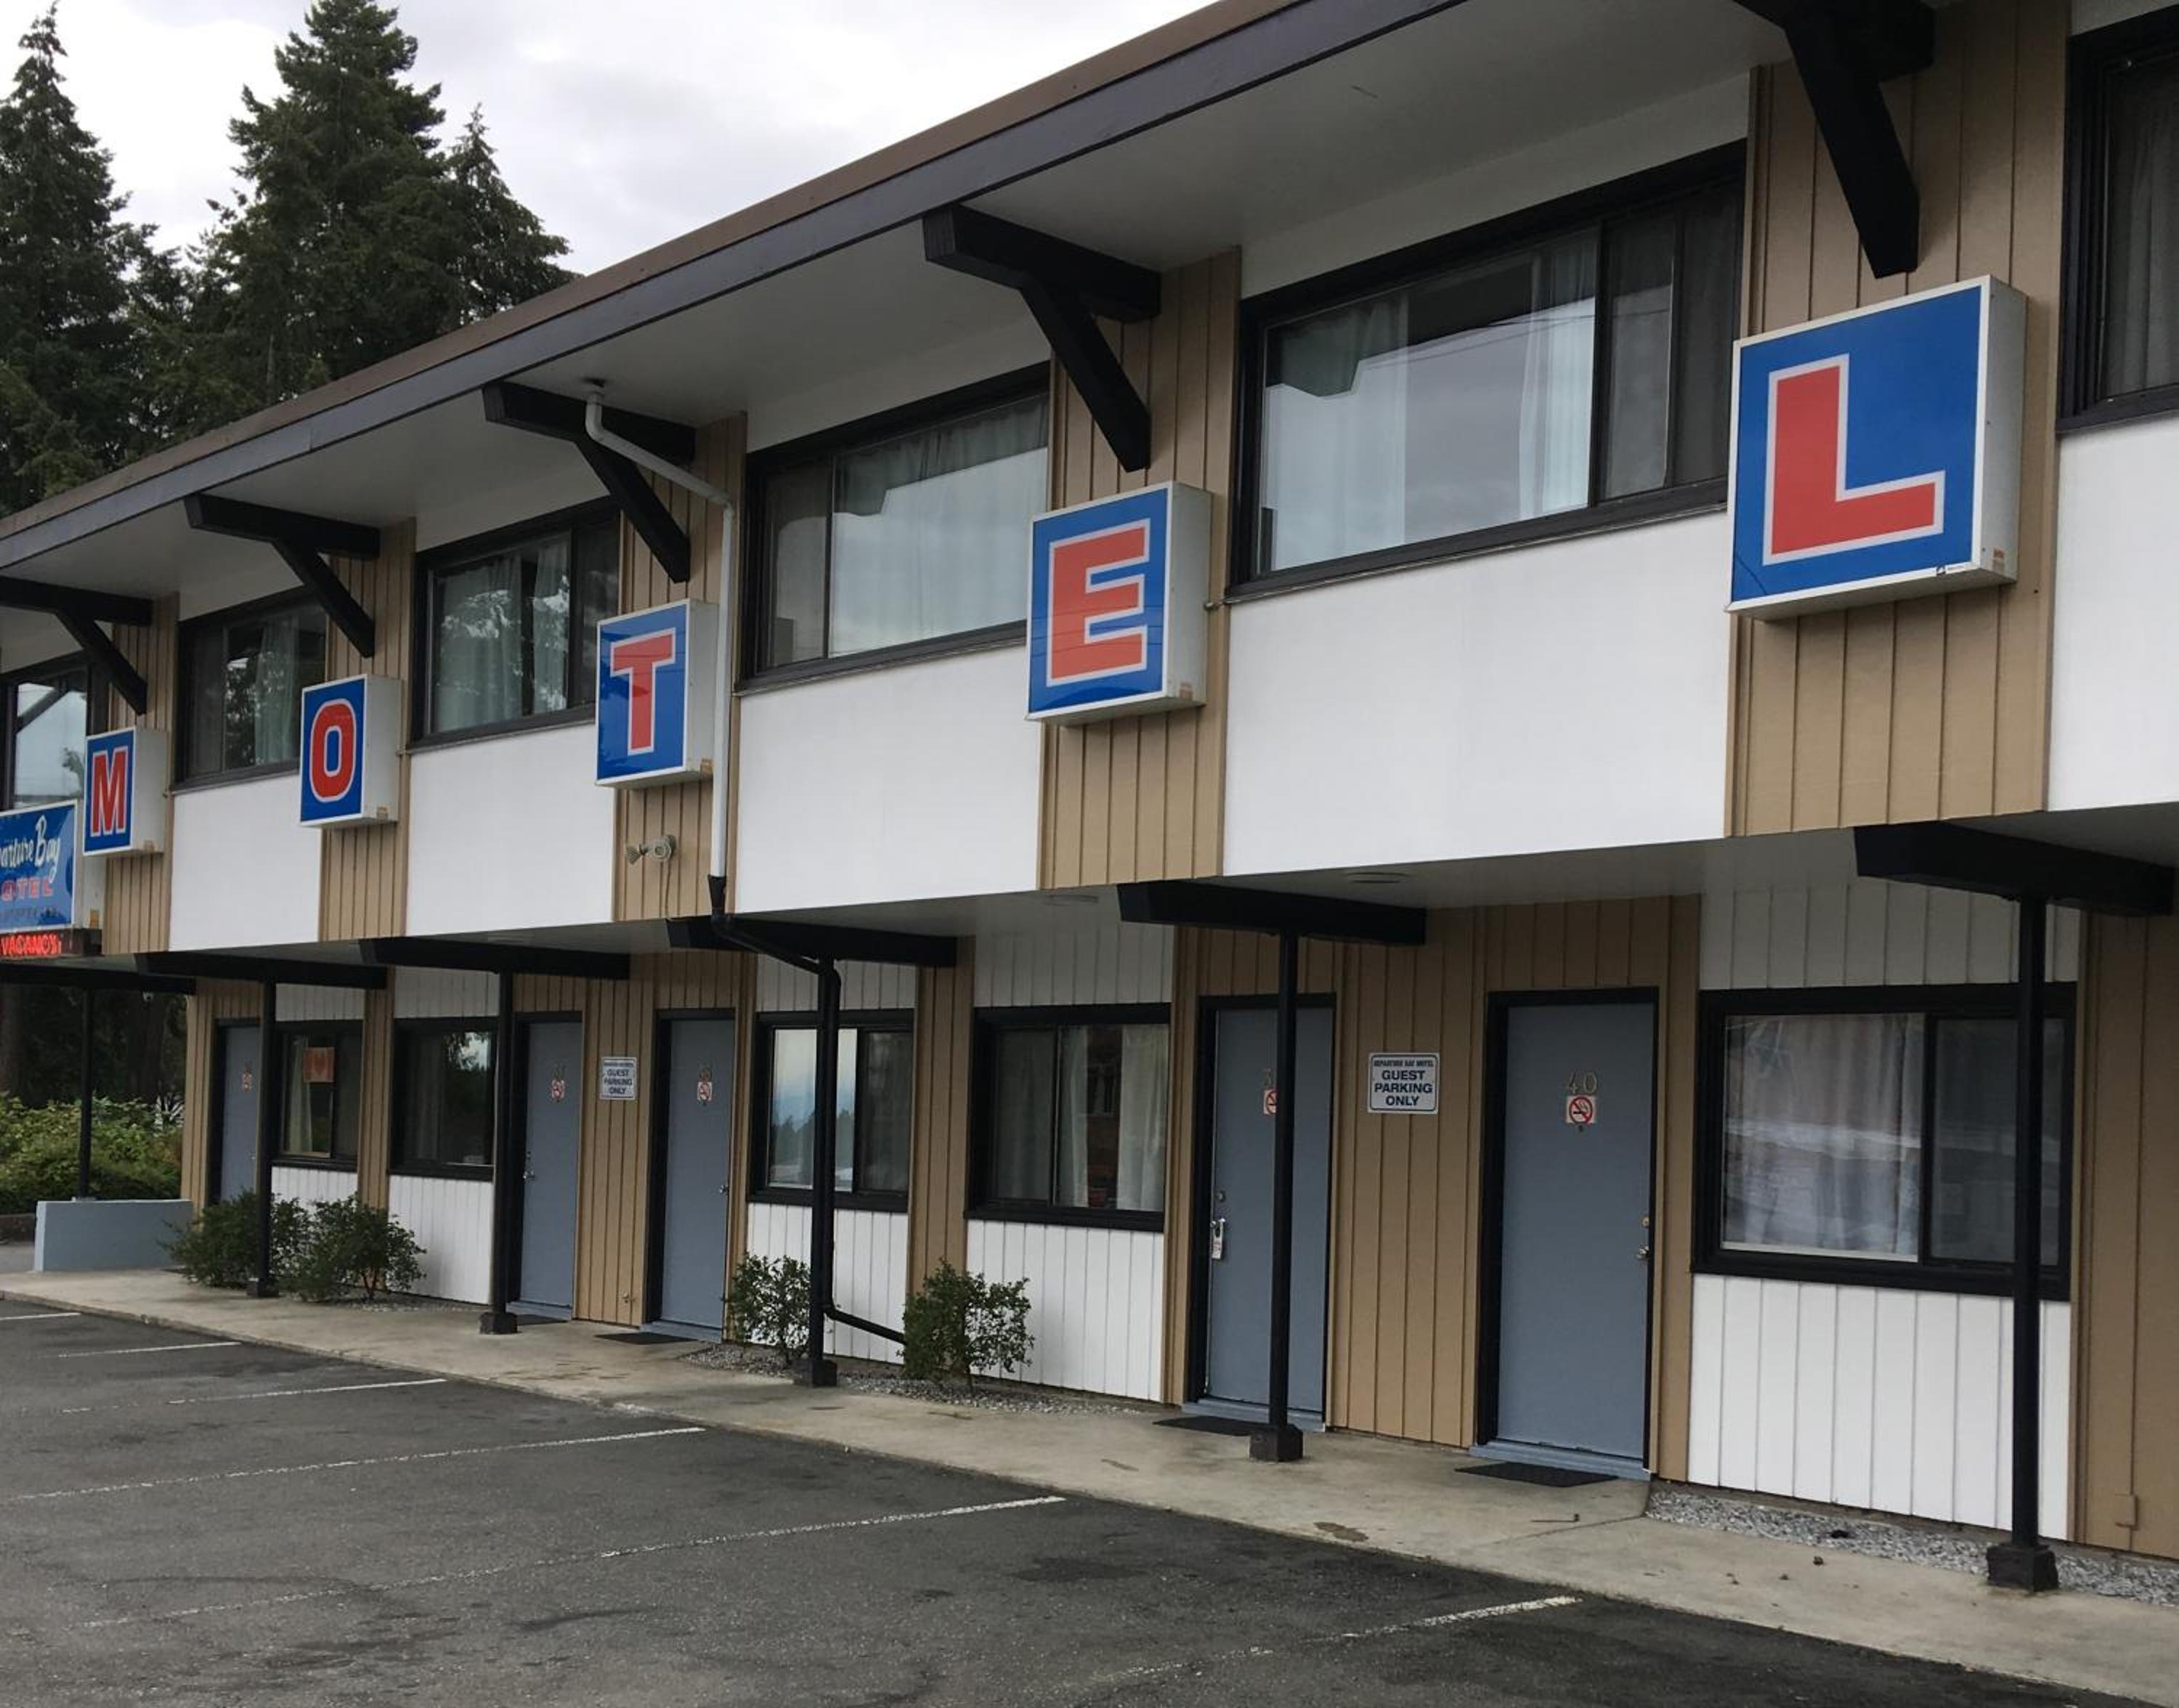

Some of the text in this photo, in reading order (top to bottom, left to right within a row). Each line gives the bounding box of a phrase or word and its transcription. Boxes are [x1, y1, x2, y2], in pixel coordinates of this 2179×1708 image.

[1762, 353, 1946, 566] L
[1046, 518, 1151, 687] E
[609, 627, 676, 756] T
[89, 745, 129, 837] M
[309, 698, 357, 803] O
[34, 814, 61, 884] Bay
[1374, 1083, 1433, 1094] PARKING
[1381, 1070, 1425, 1081] GUEST
[1385, 1095, 1419, 1106] ONLY
